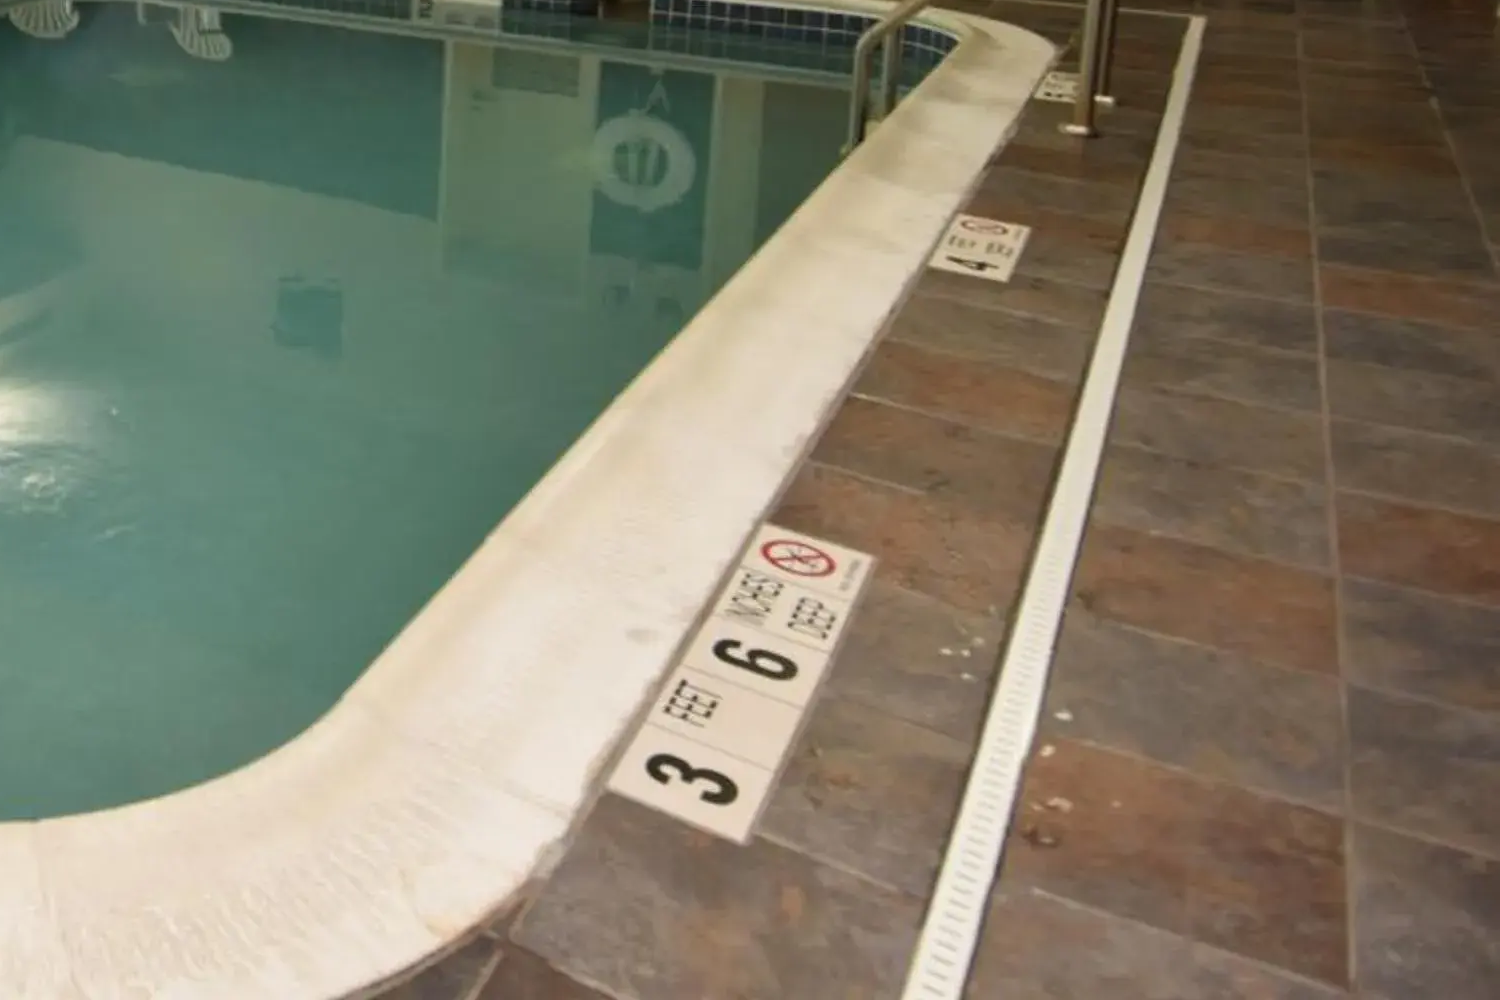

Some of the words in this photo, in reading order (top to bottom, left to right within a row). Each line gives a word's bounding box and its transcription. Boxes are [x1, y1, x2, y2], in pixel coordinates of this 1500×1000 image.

[712, 638, 799, 681] 6
[663, 679, 724, 728] FEET
[645, 753, 739, 806] 3
